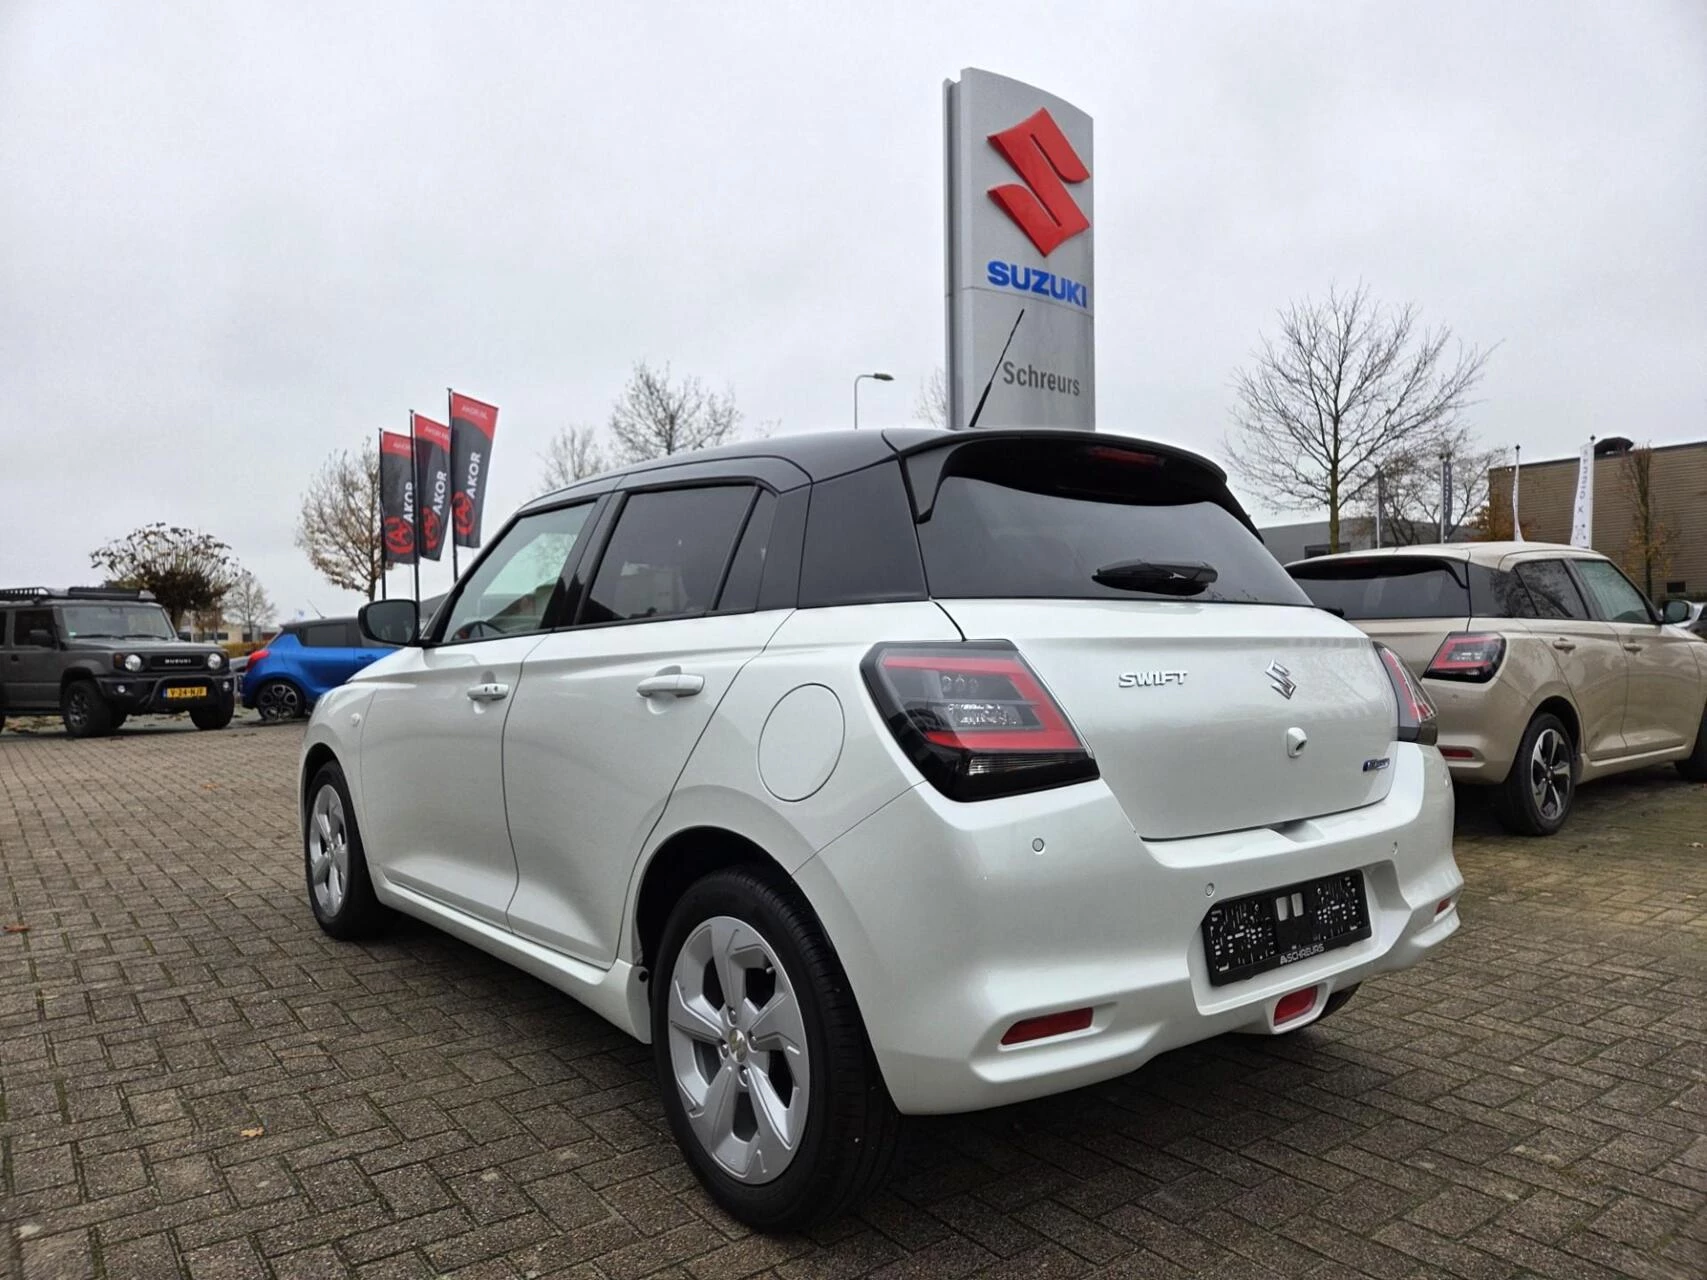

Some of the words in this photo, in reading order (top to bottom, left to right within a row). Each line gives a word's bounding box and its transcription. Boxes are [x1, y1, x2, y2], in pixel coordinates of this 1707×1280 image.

[987, 260, 1087, 309] SUZUKI
[1003, 360, 1081, 397] Schreurs
[432, 470, 447, 515] AKOR
[466, 451, 481, 499] AKOR
[1118, 670, 1188, 688] SWIFT
